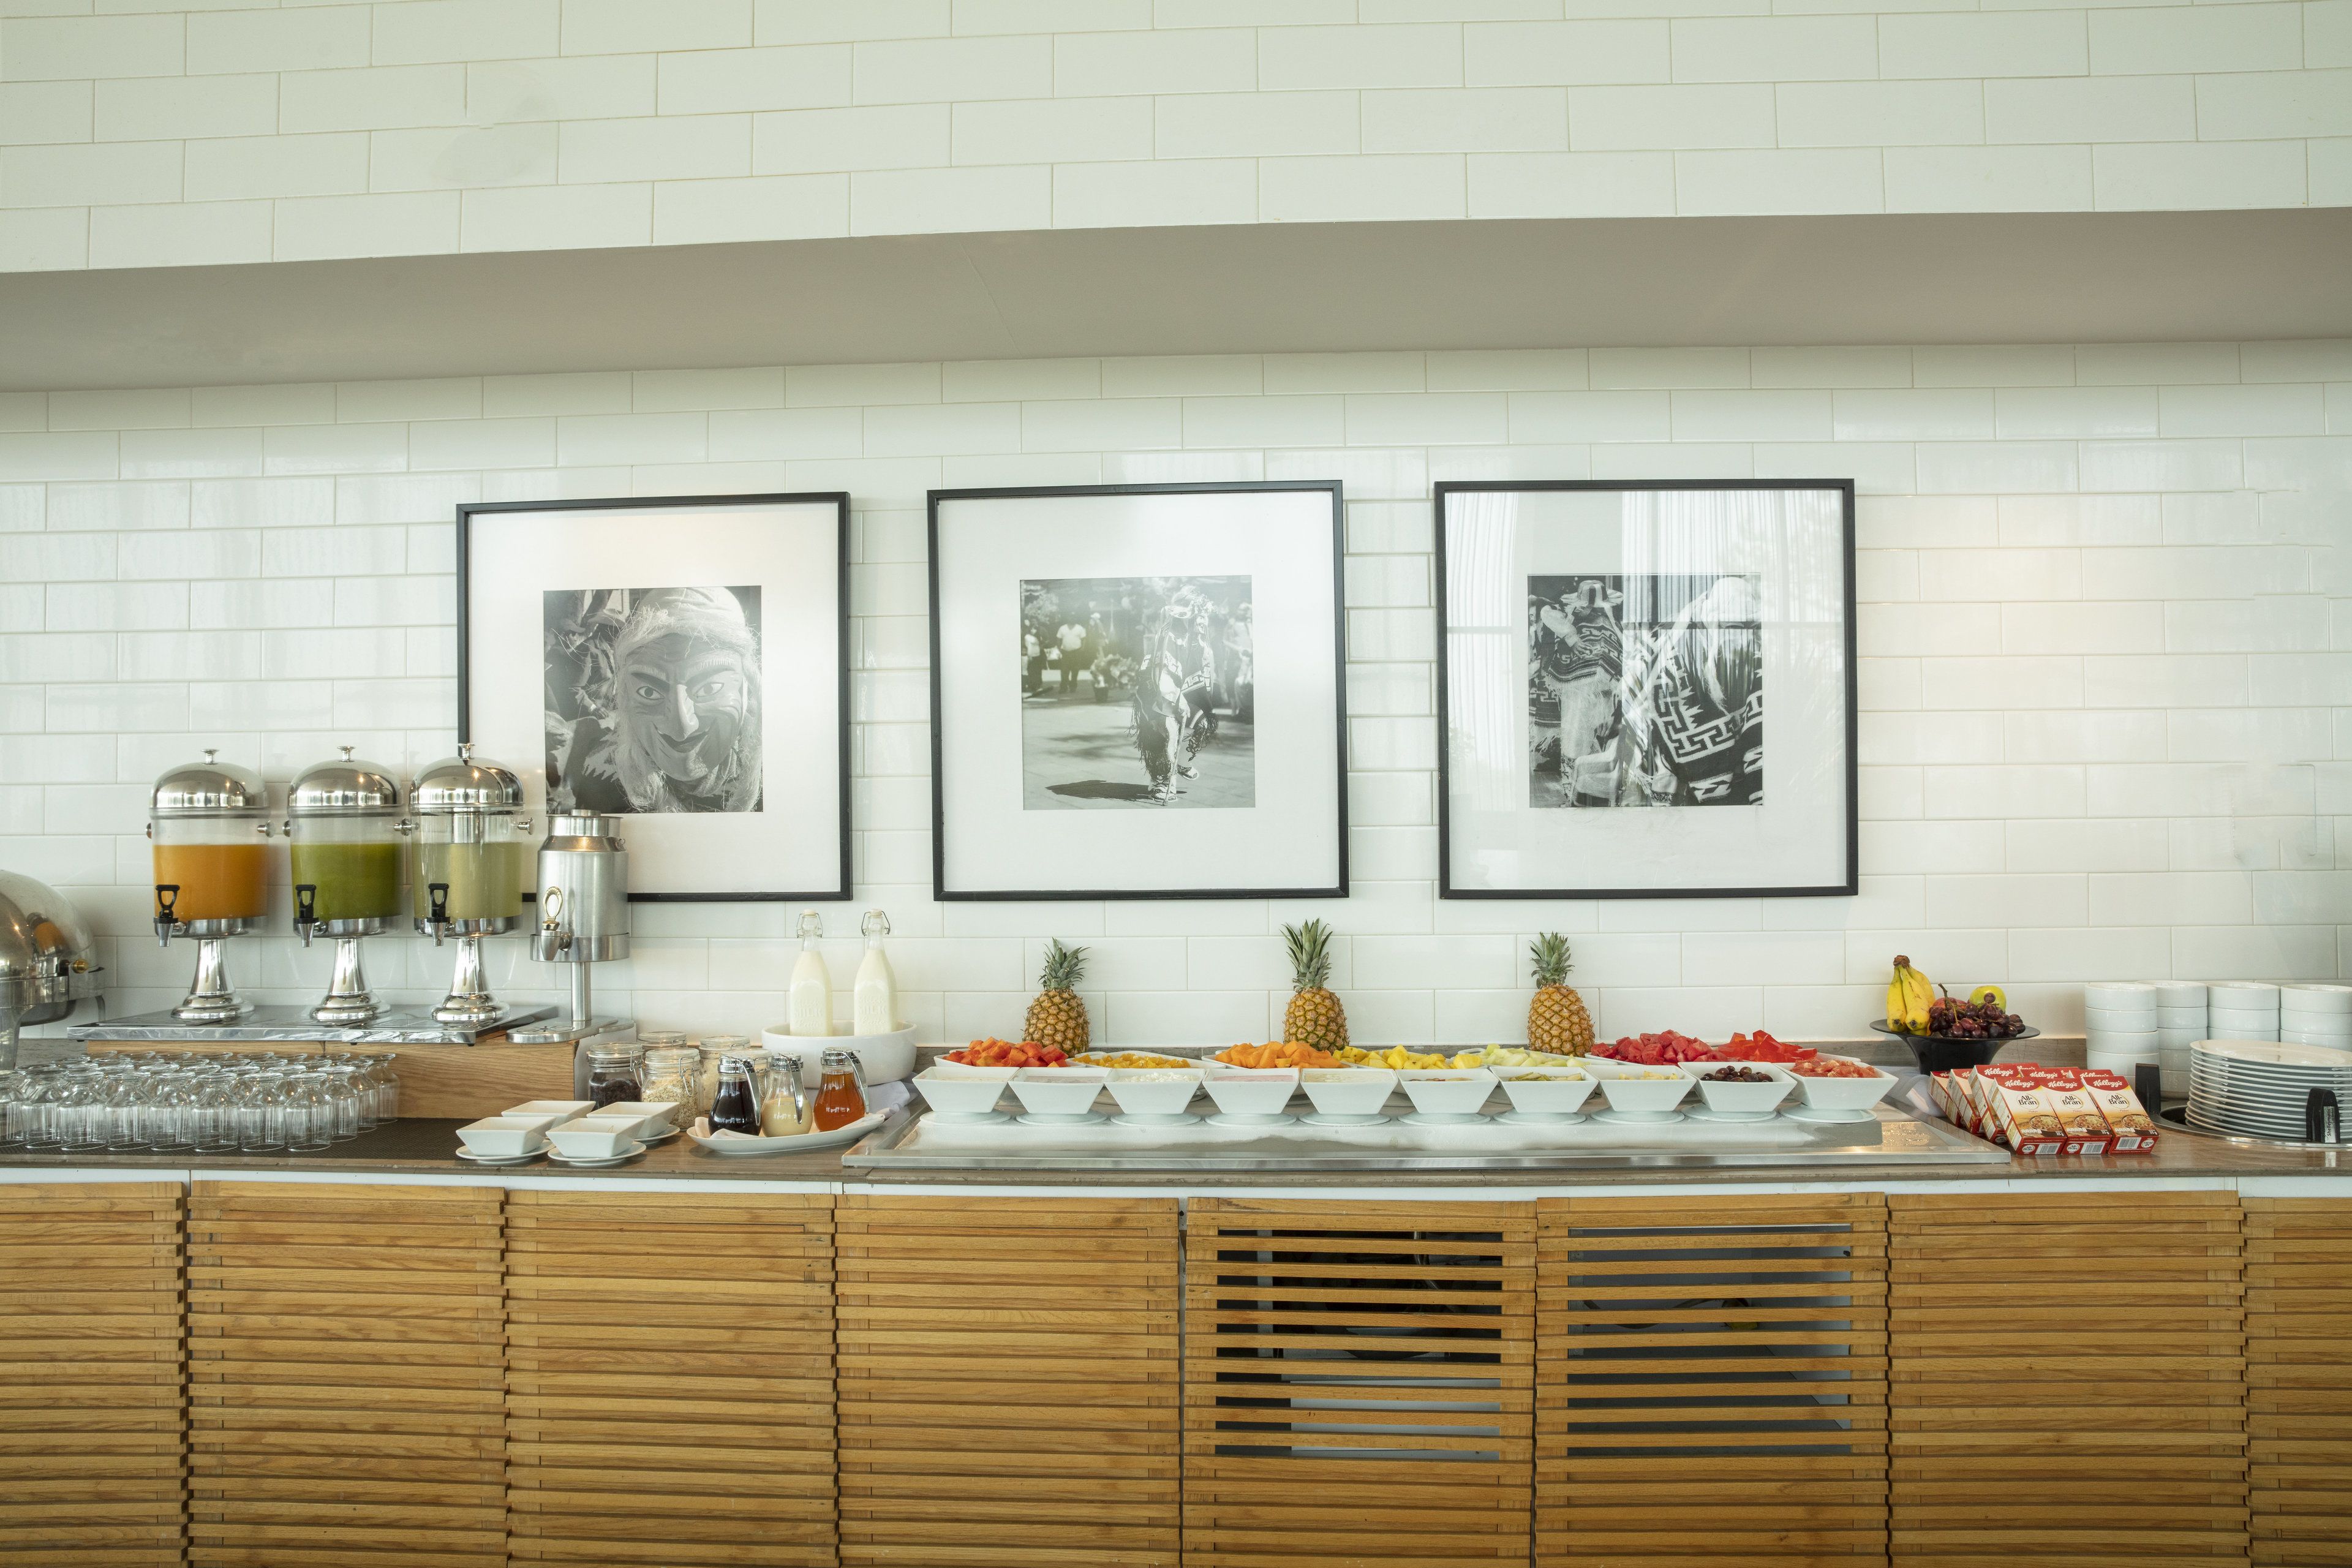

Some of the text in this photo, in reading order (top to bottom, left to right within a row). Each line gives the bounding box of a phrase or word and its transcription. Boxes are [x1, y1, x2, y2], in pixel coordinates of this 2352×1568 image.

[794, 1008, 823, 1017] MILK
[858, 1005, 887, 1015] MILK
[1985, 1068, 2014, 1077] Kellogg's
[2005, 1079, 2034, 1088] Kellogg's
